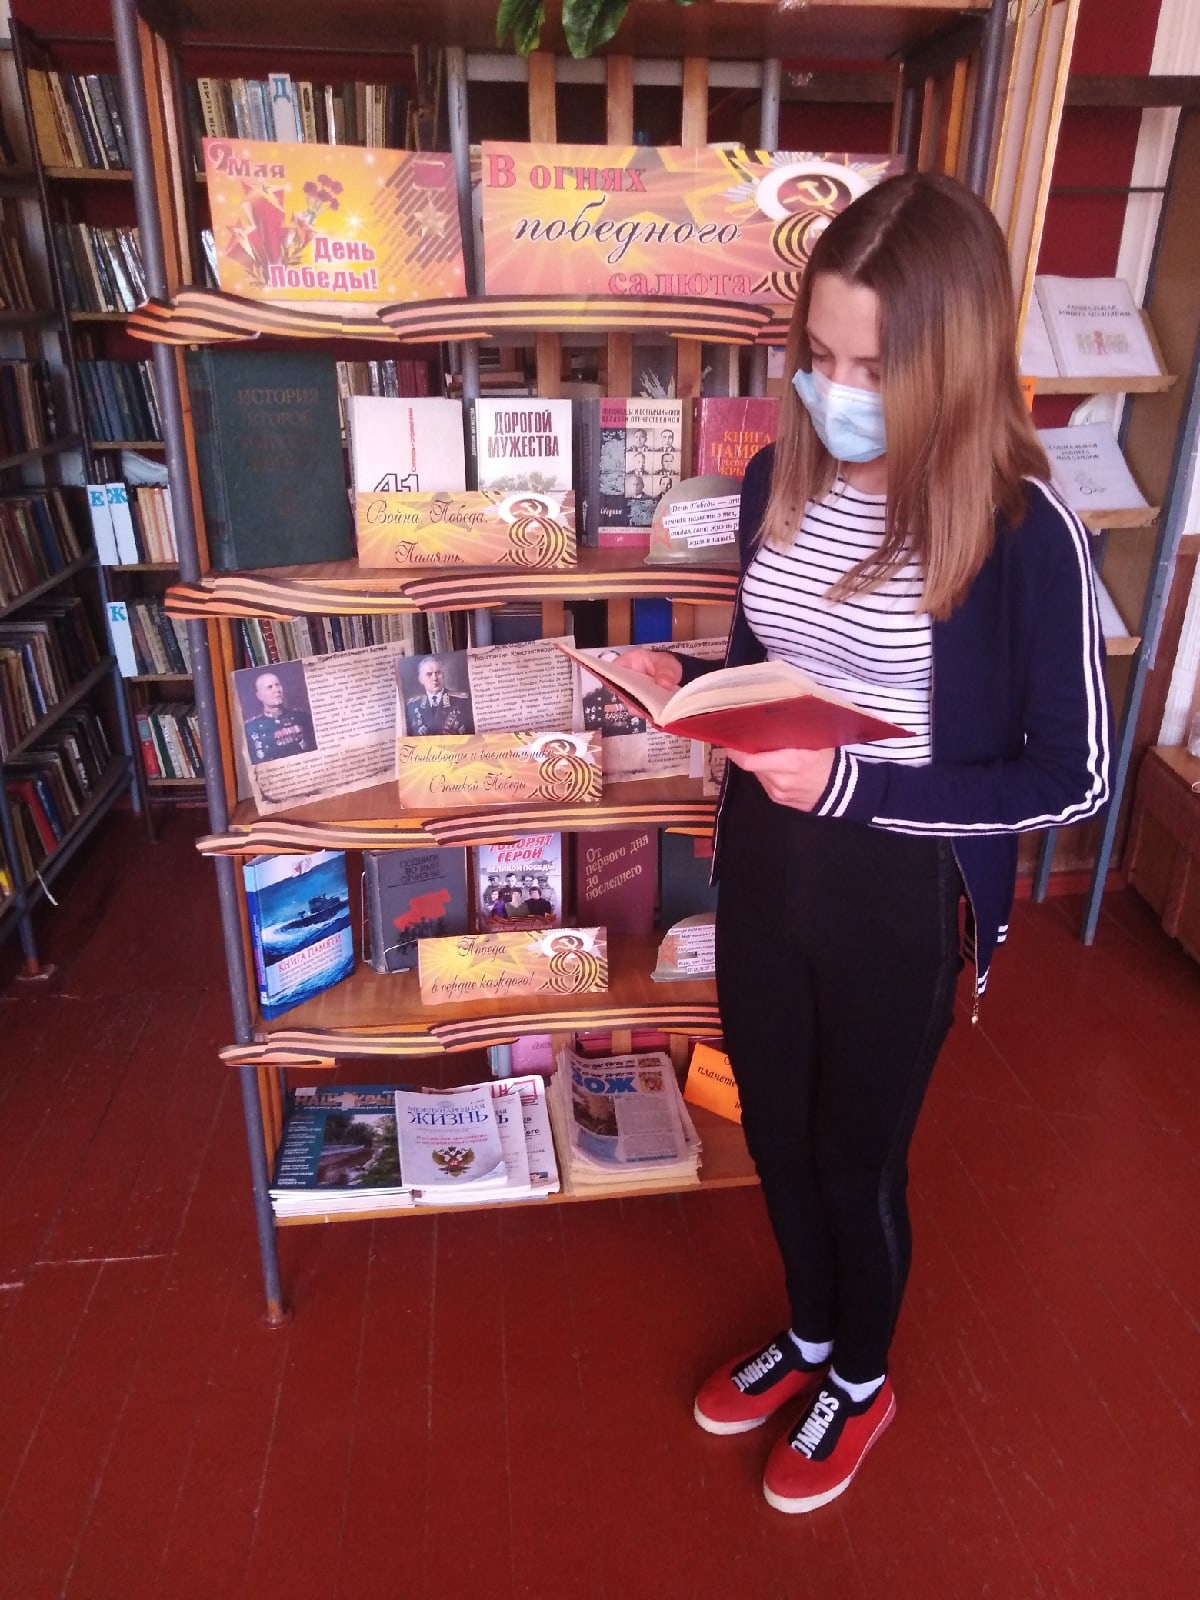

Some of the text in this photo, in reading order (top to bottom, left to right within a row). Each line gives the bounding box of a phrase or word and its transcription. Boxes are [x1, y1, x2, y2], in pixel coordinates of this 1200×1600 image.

[208, 142, 285, 179] 9 Мая
[486, 153, 647, 193] В огнях
[513, 194, 743, 264] победного
[314, 236, 376, 262] День
[268, 264, 379, 292] Победы!
[608, 271, 753, 296] салюта
[494, 409, 553, 435] ДОРОГОЙ
[487, 434, 560, 458] МУЖЕСТВА
[724, 431, 771, 443] КНИГА
[710, 442, 766, 459] ПАМЯ
[373, 473, 420, 492] 41
[107, 487, 128, 504] Ж
[429, 499, 488, 532] Победа.
[395, 540, 464, 563] Память.
[111, 605, 127, 622] К
[483, 772, 526, 796] Победы
[497, 848, 543, 862] ГЕРОИ
[585, 835, 649, 875] первого дня
[586, 847, 602, 863] От
[585, 865, 642, 902] последнего
[586, 875, 599, 891] до
[278, 952, 306, 973] КНИГА
[307, 933, 342, 958] ПАМЯТИ
[457, 936, 507, 963] Победа
[441, 974, 477, 998] сердце
[408, 1110, 489, 1126] ЖИЗНЬ
